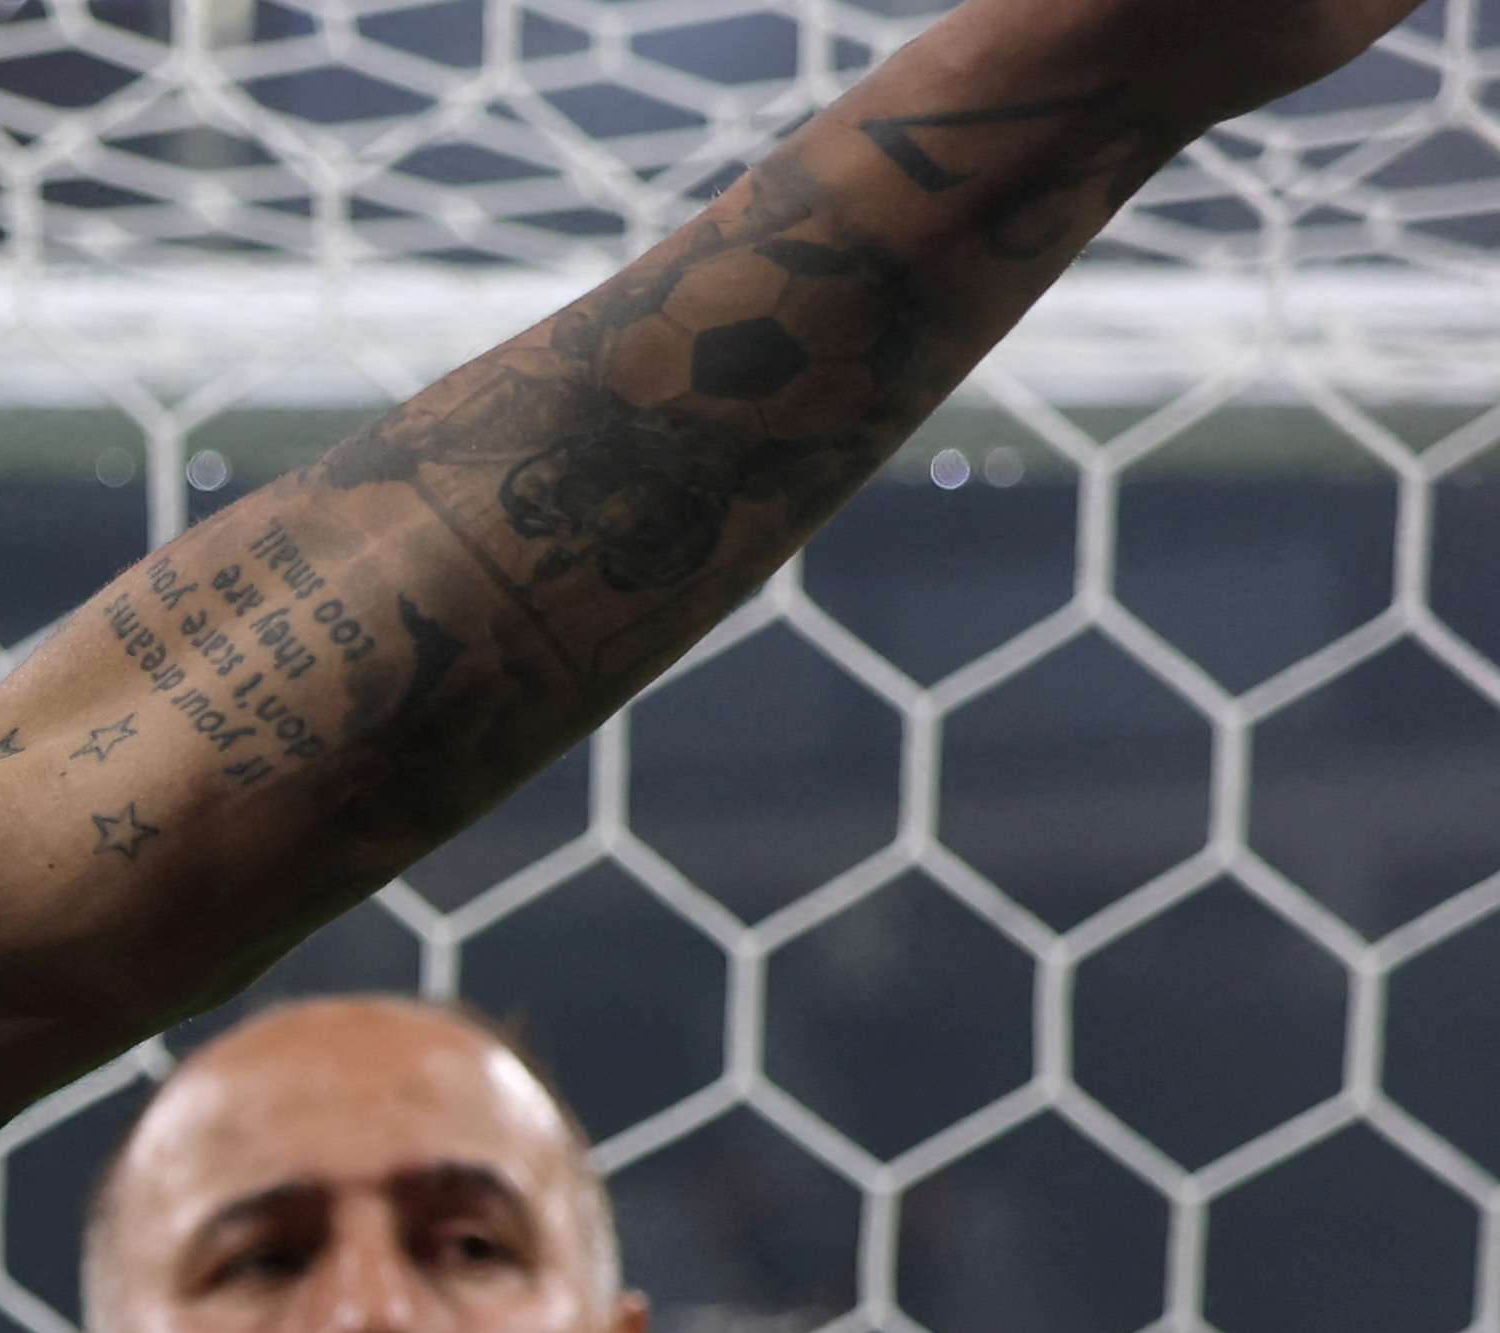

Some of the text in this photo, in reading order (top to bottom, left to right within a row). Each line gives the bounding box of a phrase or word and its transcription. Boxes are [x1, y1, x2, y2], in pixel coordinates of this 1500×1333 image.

[211, 564, 264, 617] are
[314, 600, 376, 662] too
[170, 689, 256, 751] your
